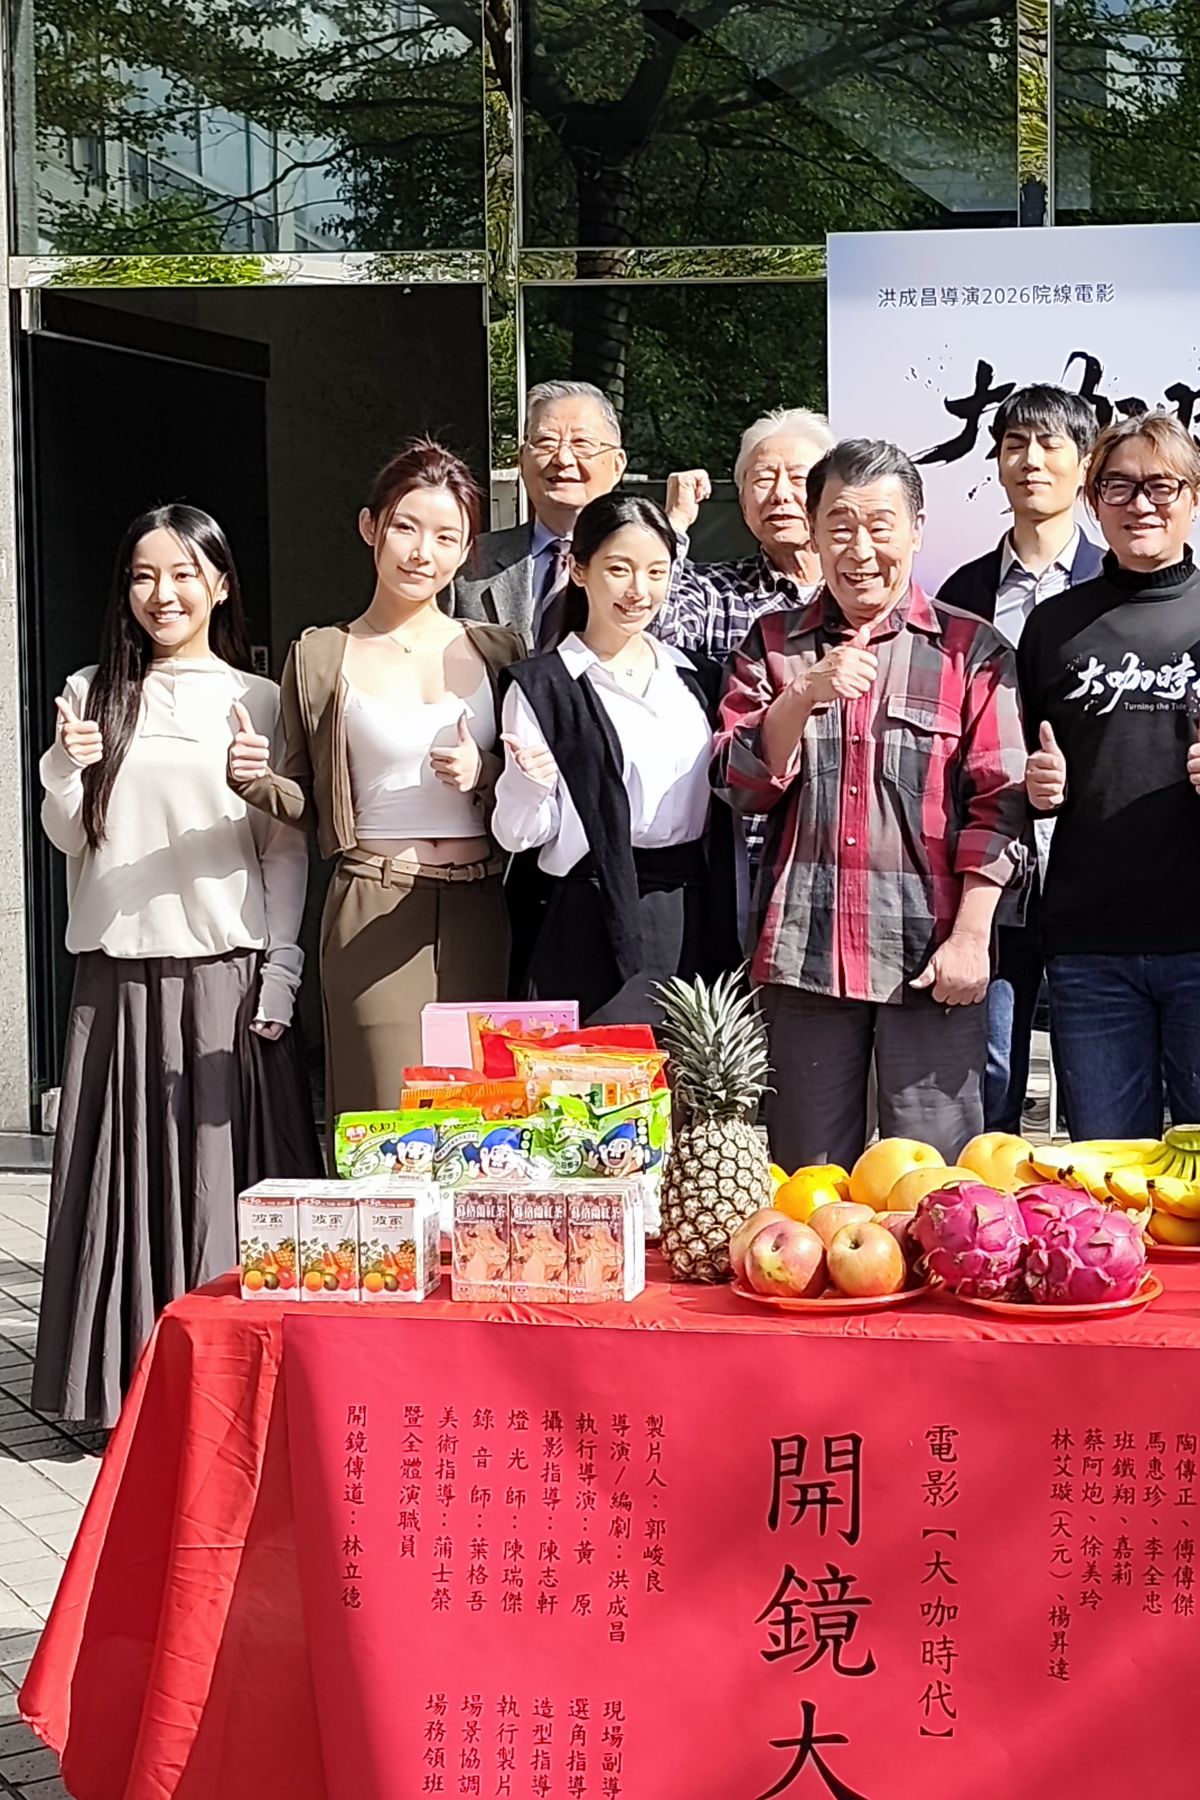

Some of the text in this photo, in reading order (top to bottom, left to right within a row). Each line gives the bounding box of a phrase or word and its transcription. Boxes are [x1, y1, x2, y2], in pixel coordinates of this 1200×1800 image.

[877, 283, 1115, 308] 洪成昌導演2026院線電影
[1124, 702, 1154, 712] Turning
[1156, 702, 1169, 711] the
[753, 1432, 877, 1800] 開鏡大
